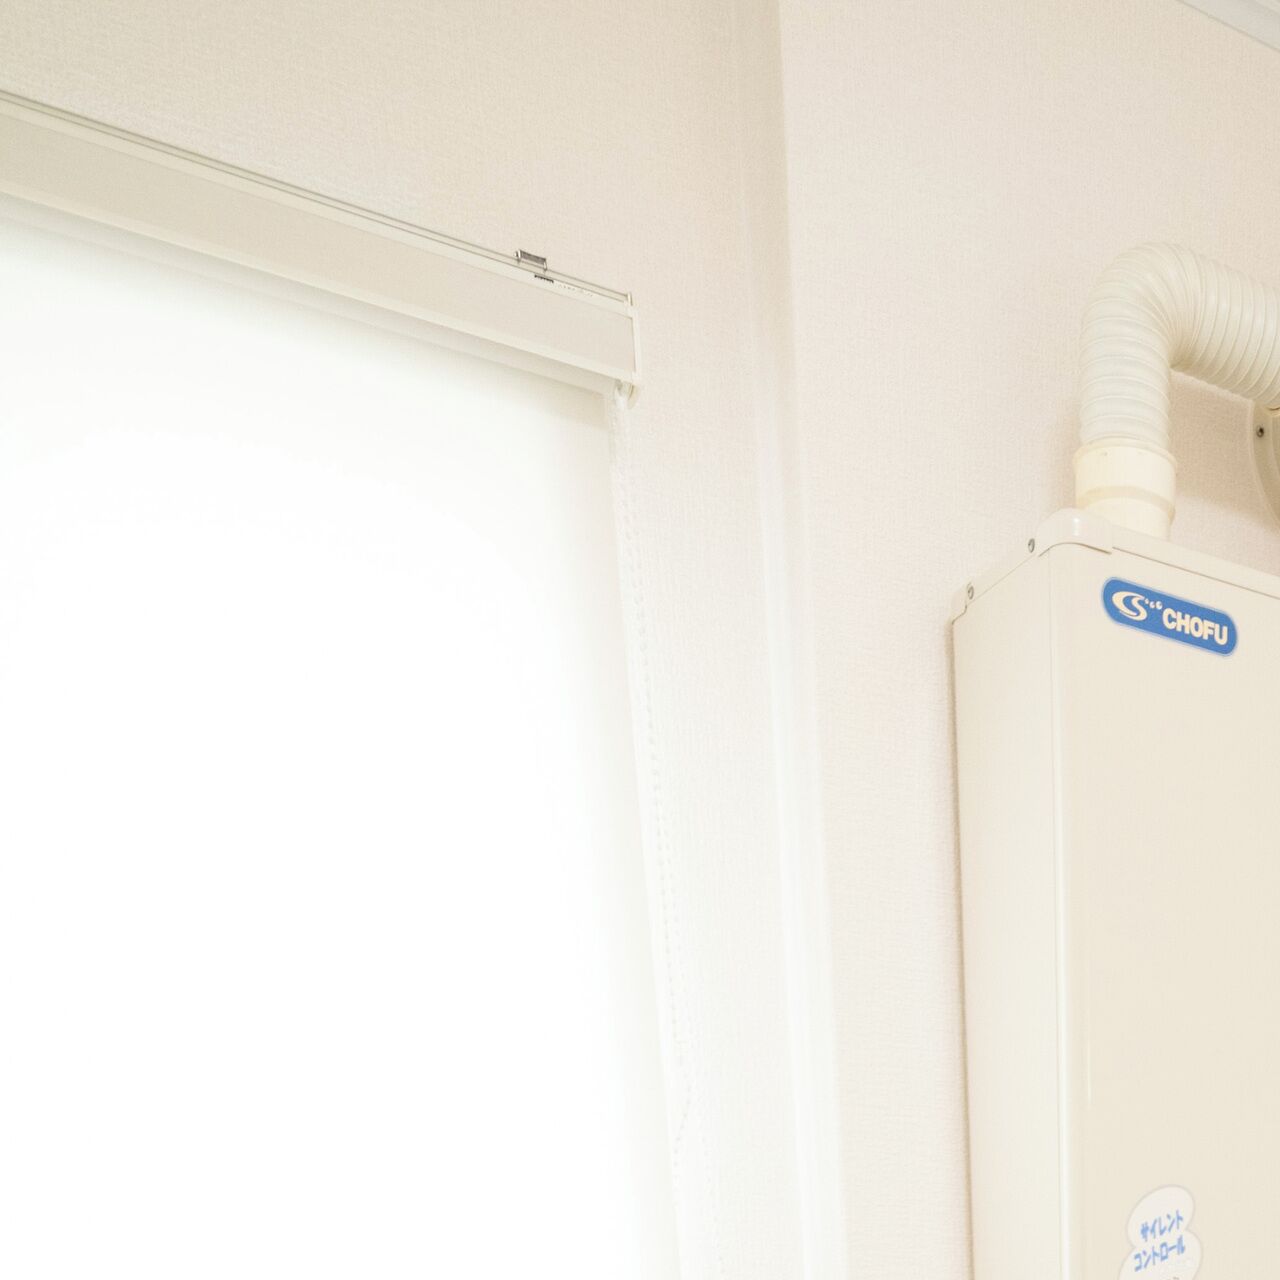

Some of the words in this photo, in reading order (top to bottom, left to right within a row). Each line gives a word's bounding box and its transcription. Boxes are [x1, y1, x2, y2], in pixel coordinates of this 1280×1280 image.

[1162, 608, 1228, 645] CHOFU
[1140, 1209, 1183, 1242] サイレント
[1134, 1235, 1185, 1272] コントロール
